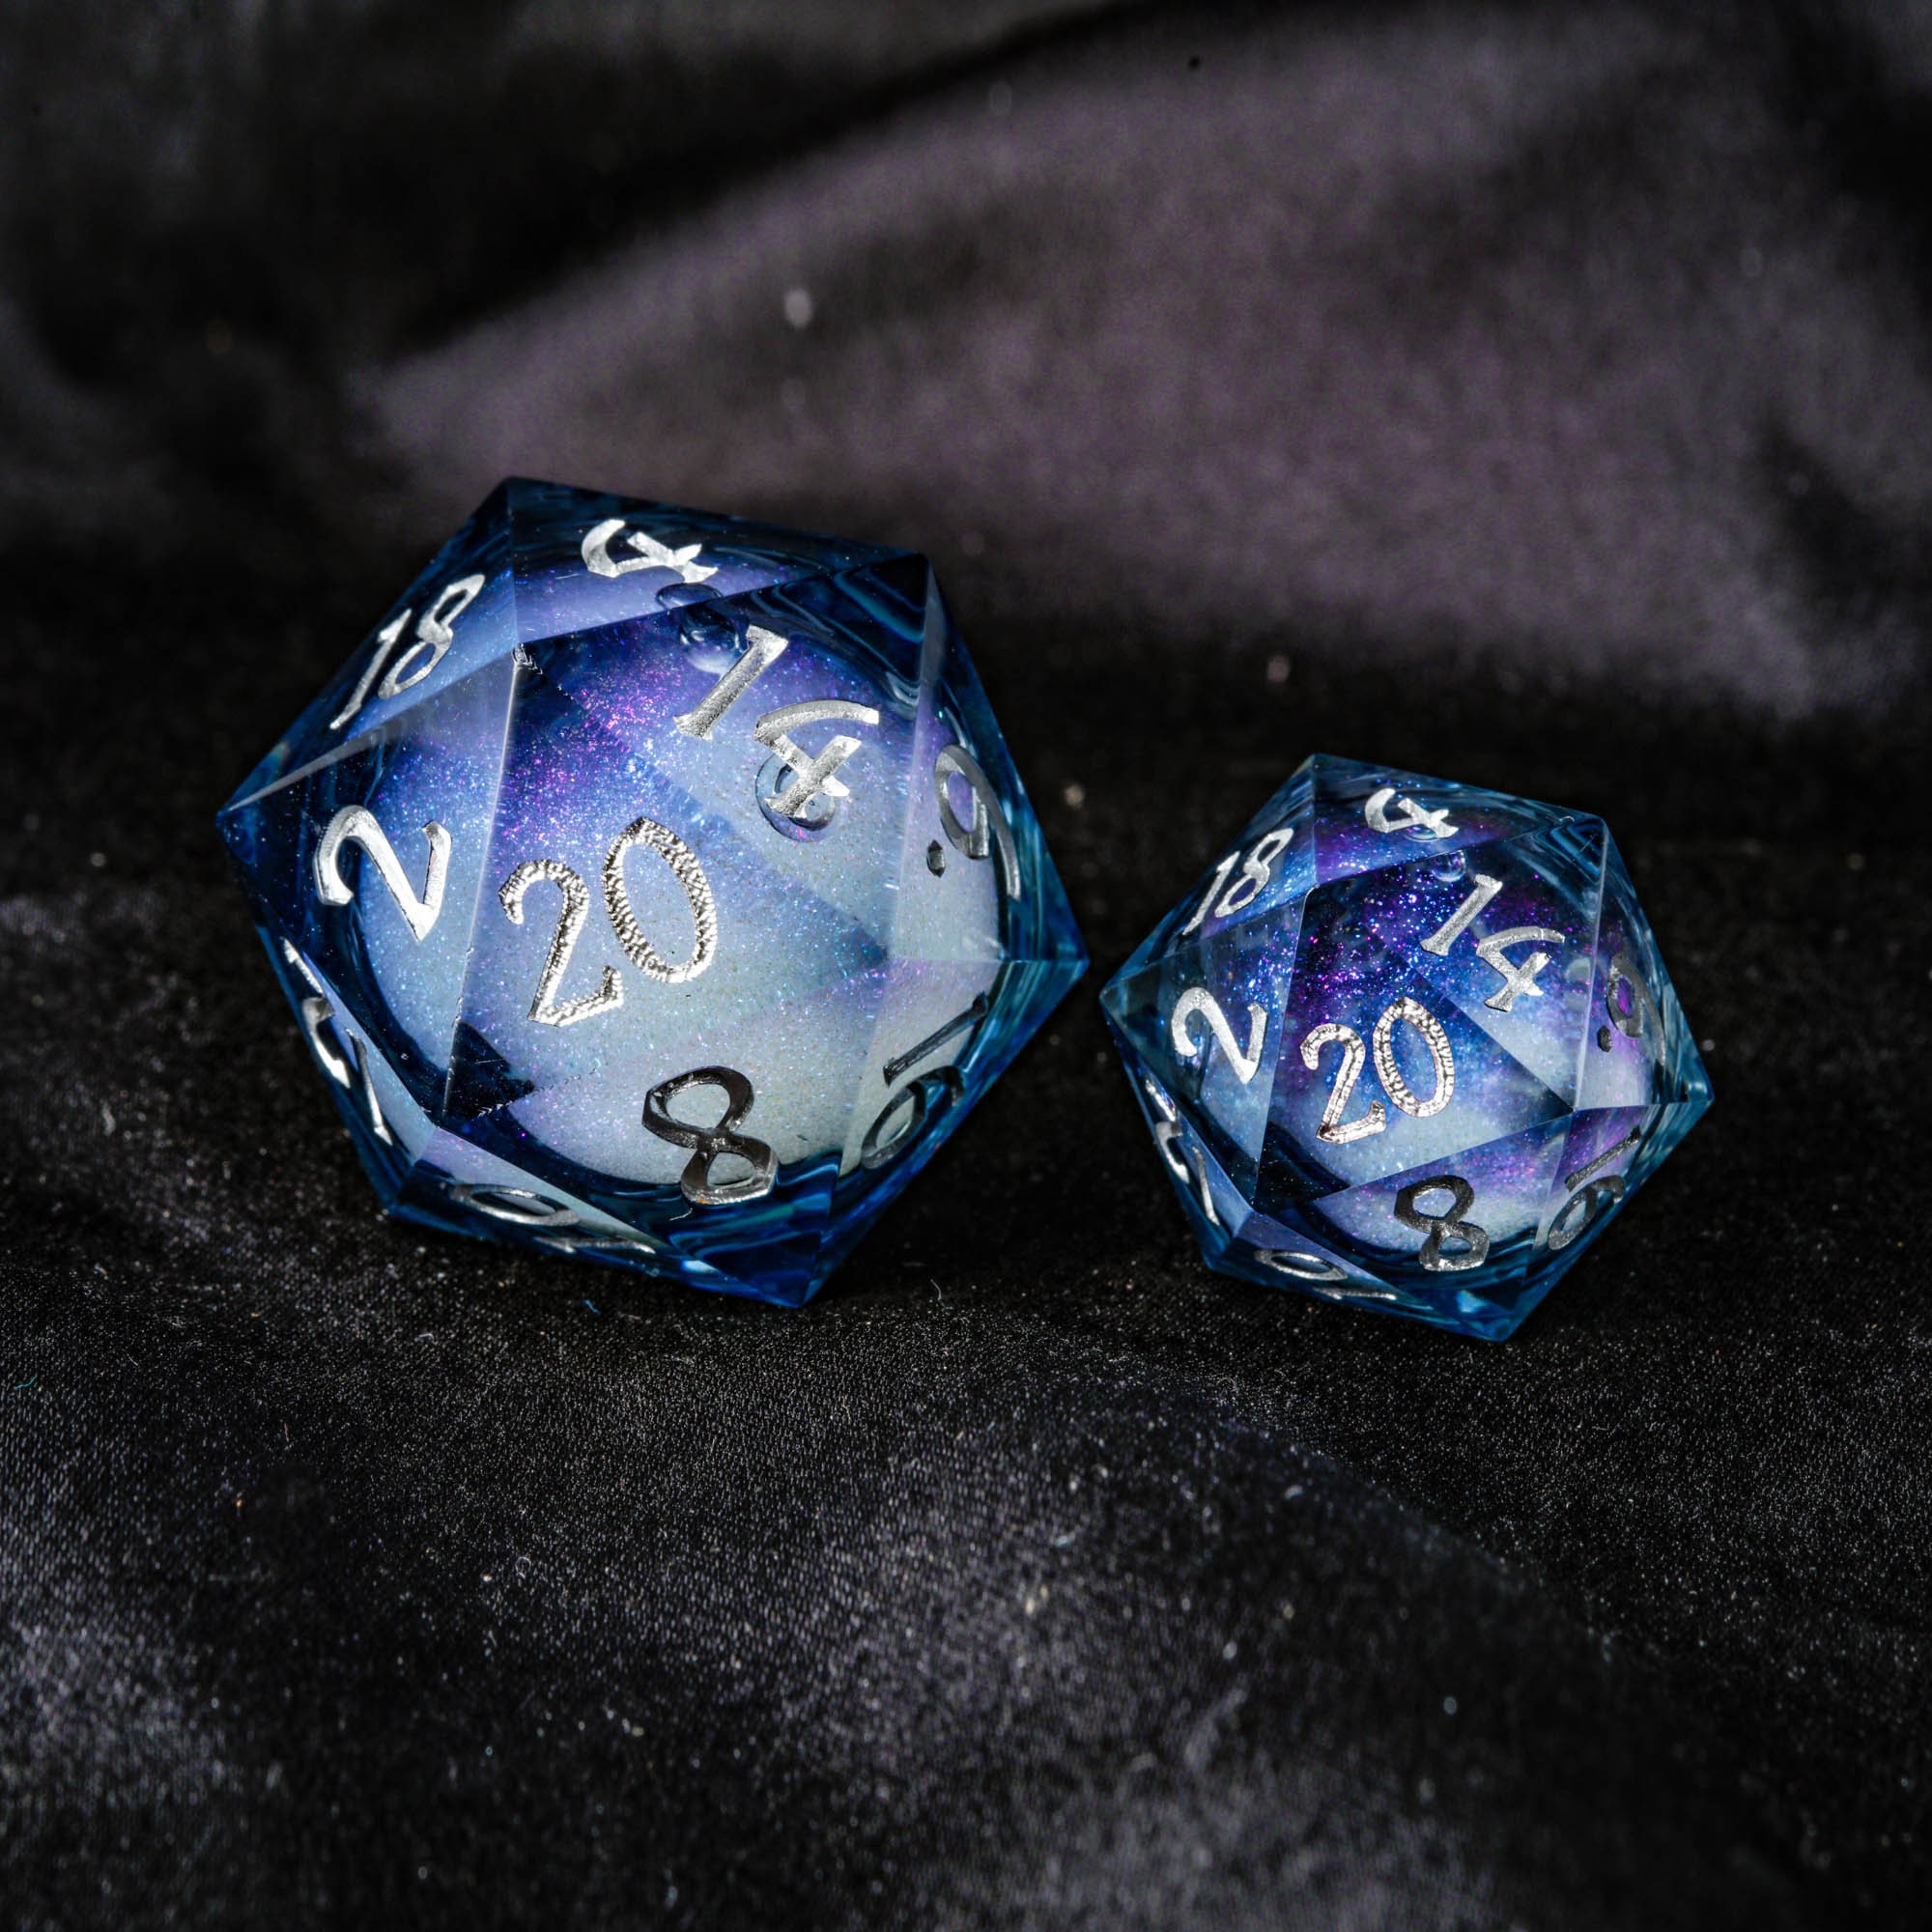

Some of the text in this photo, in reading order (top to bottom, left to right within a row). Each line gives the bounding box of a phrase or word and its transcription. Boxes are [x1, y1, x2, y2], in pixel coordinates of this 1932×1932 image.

[582, 519, 718, 583] 4
[329, 574, 485, 730] 18
[674, 624, 880, 819] 14
[313, 805, 452, 944] 2
[1182, 828, 1294, 935] 18
[1365, 788, 1460, 838] 4
[497, 816, 718, 1027] 20
[1420, 873, 1566, 1013] 14
[862, 991, 989, 1170] 16
[1171, 987, 1268, 1085] 2
[1300, 996, 1455, 1144] 20
[641, 1065, 779, 1206] 8
[1548, 1124, 1641, 1250] 16
[1394, 1175, 1490, 1271] 8
